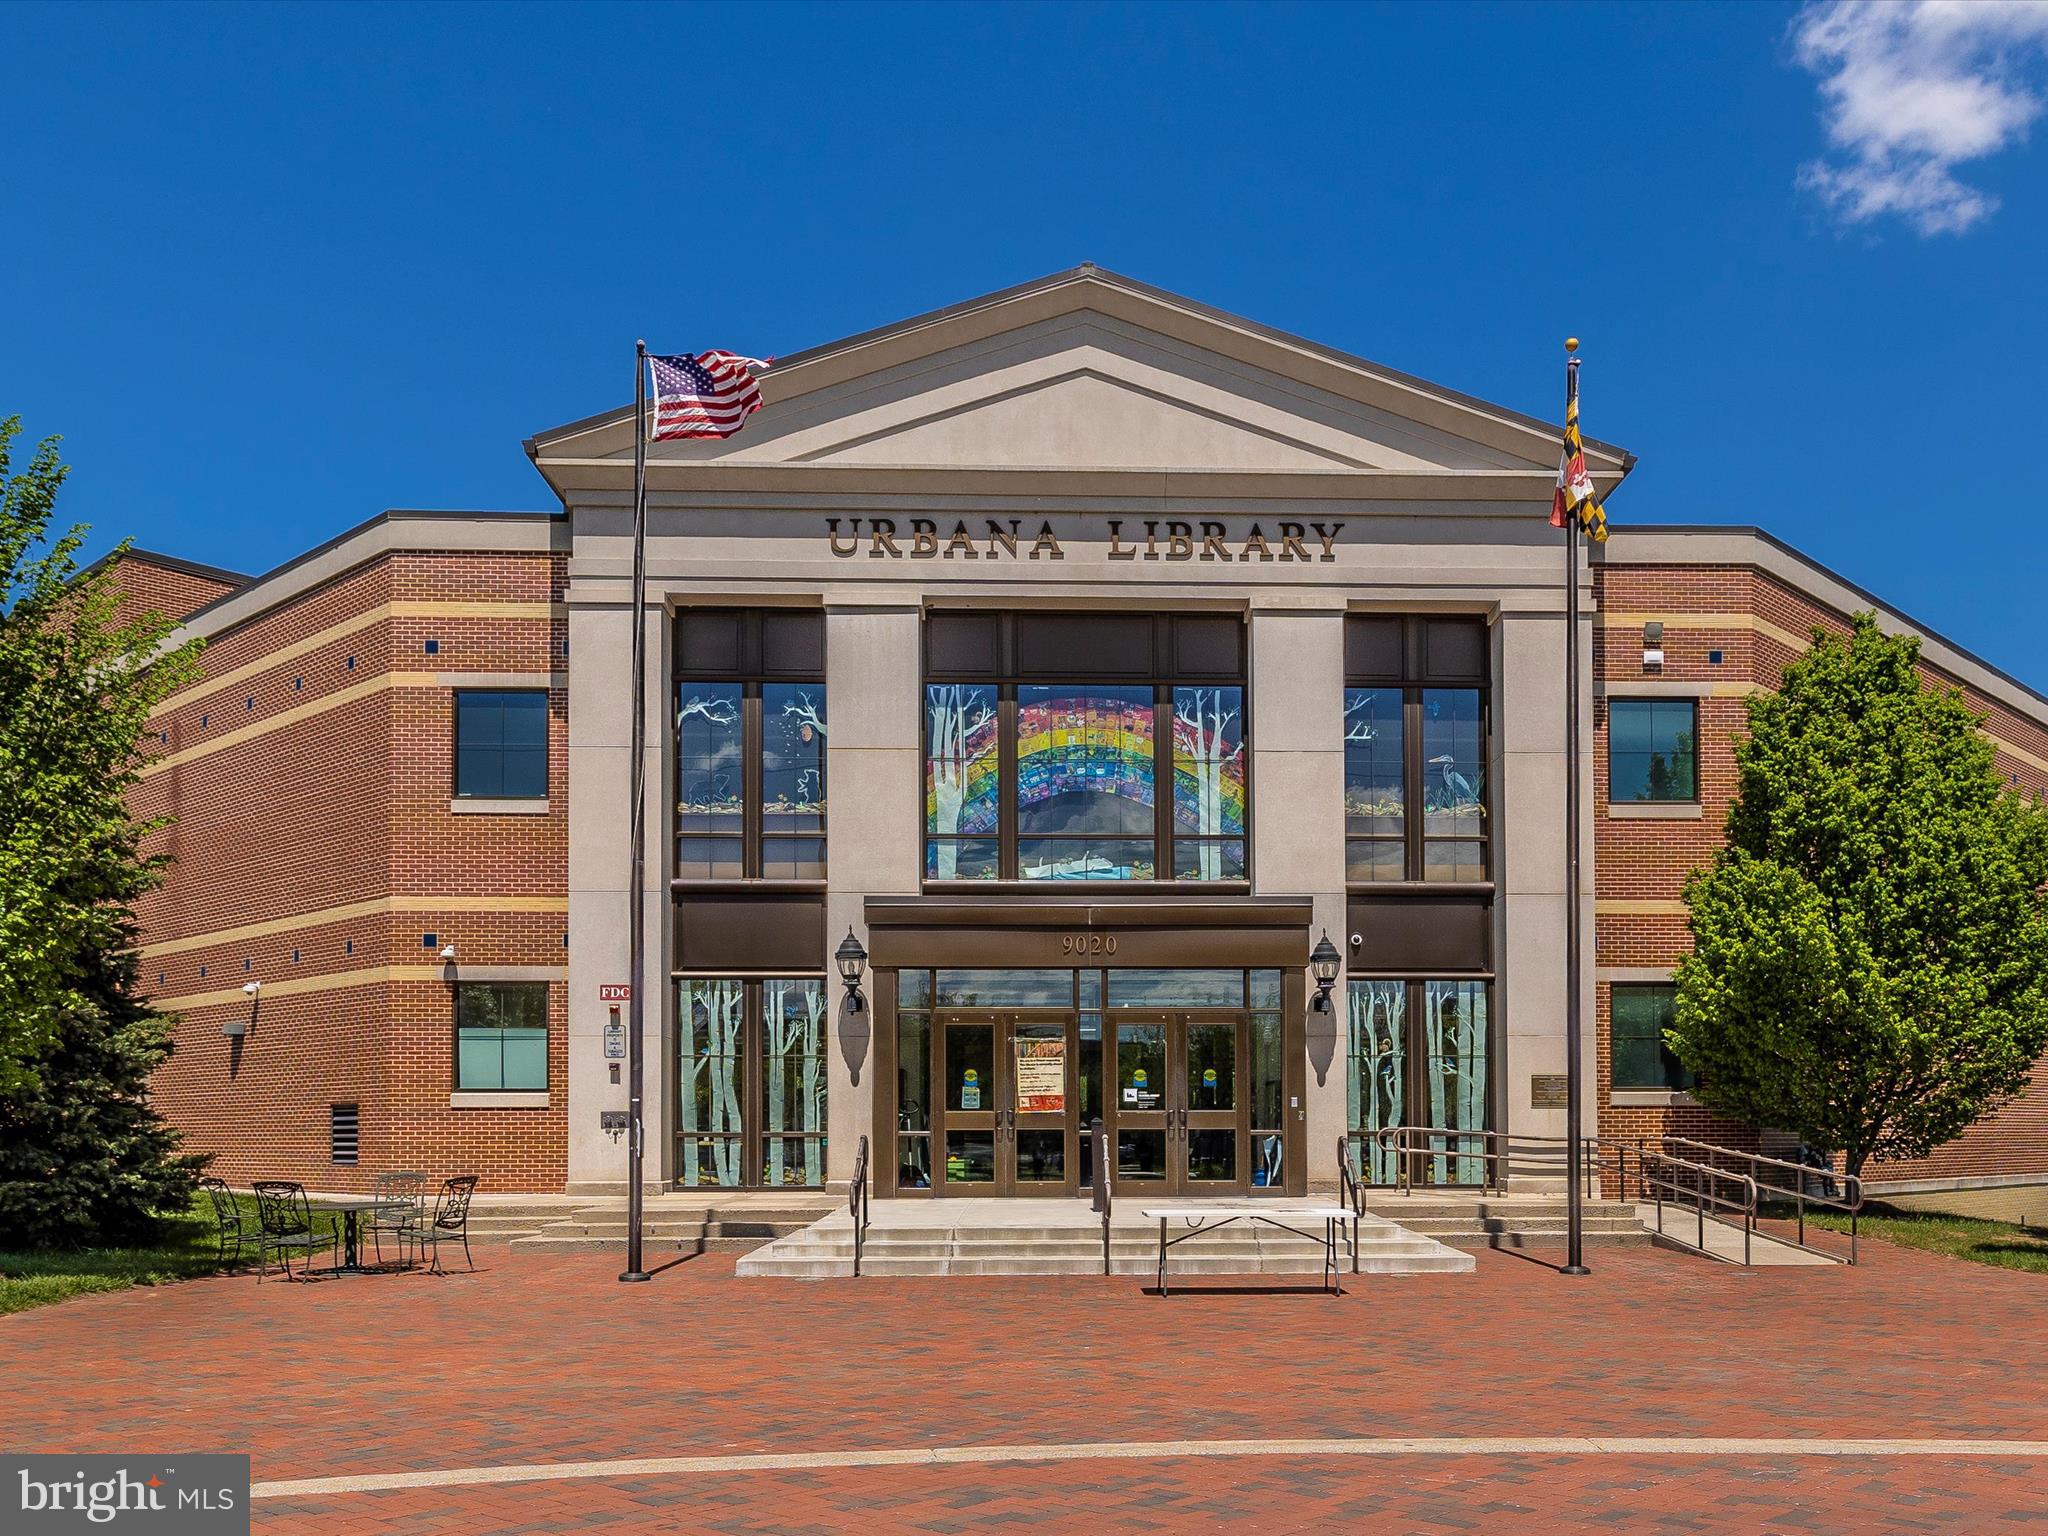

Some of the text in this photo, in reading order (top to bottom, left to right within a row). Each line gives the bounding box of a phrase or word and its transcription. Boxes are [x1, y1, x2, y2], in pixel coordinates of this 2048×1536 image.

[825, 518, 1345, 562] URBANA LIBRARY
[1062, 935, 1117, 954] 9020
[601, 987, 630, 998] FDC
